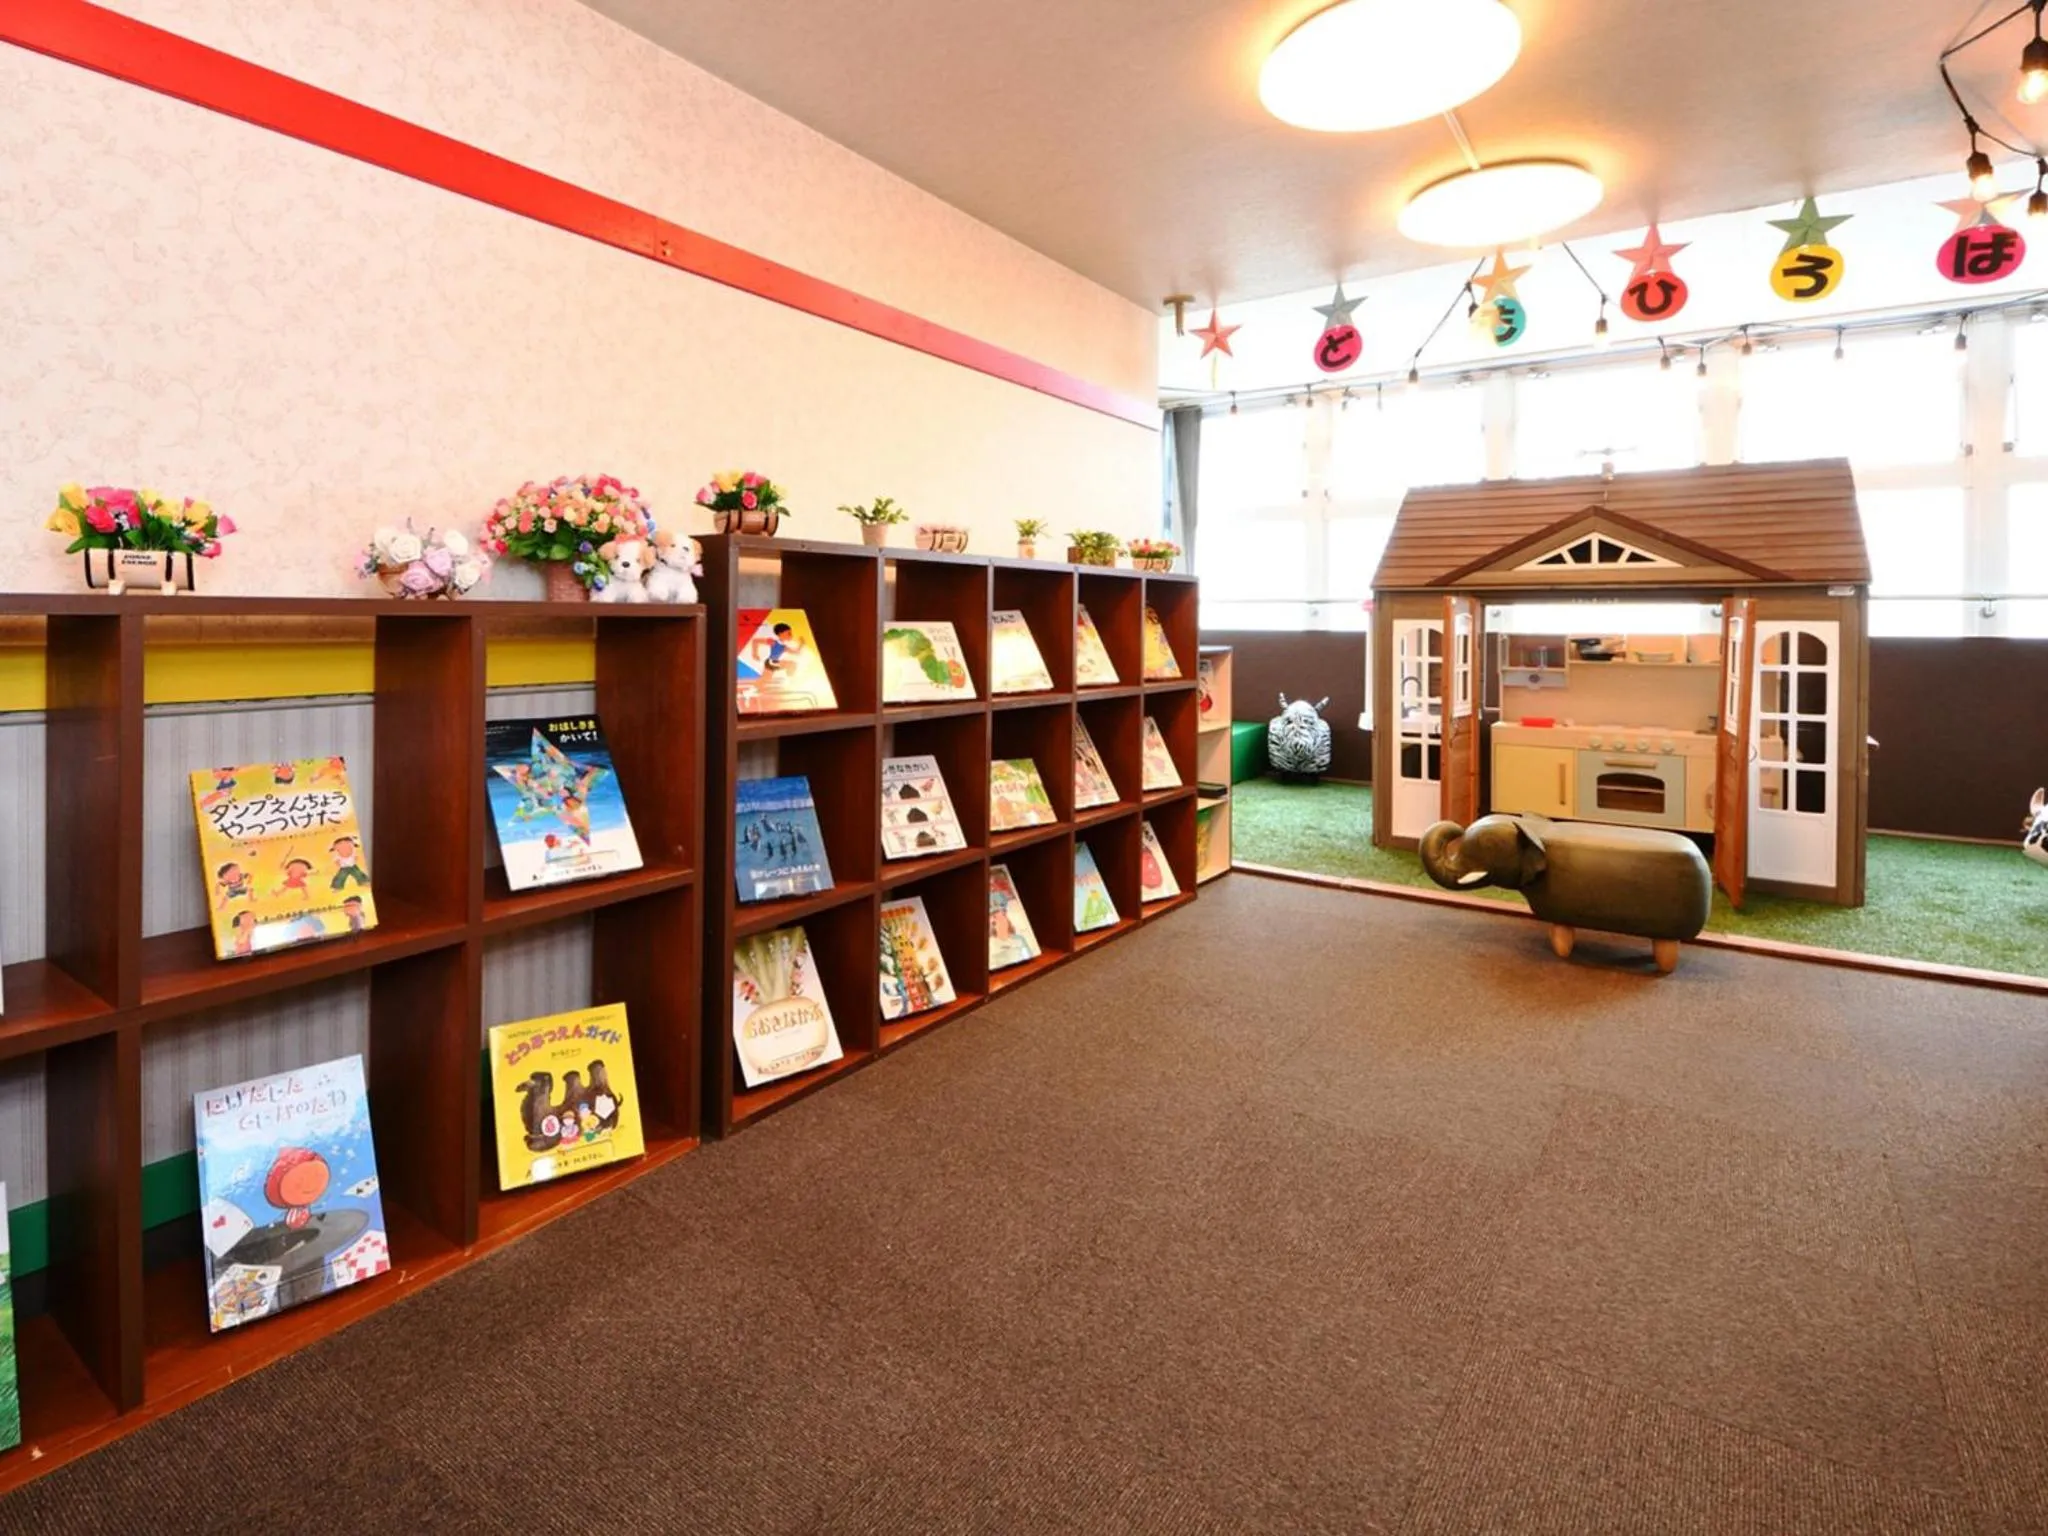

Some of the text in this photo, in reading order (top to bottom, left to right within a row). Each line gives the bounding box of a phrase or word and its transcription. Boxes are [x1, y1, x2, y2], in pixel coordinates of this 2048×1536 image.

[1628, 278, 1678, 315] ひ
[1782, 253, 1834, 298] ろ
[209, 791, 348, 824] ダンプえんちょう
[504, 1023, 622, 1067] どうぶつえんガイド
